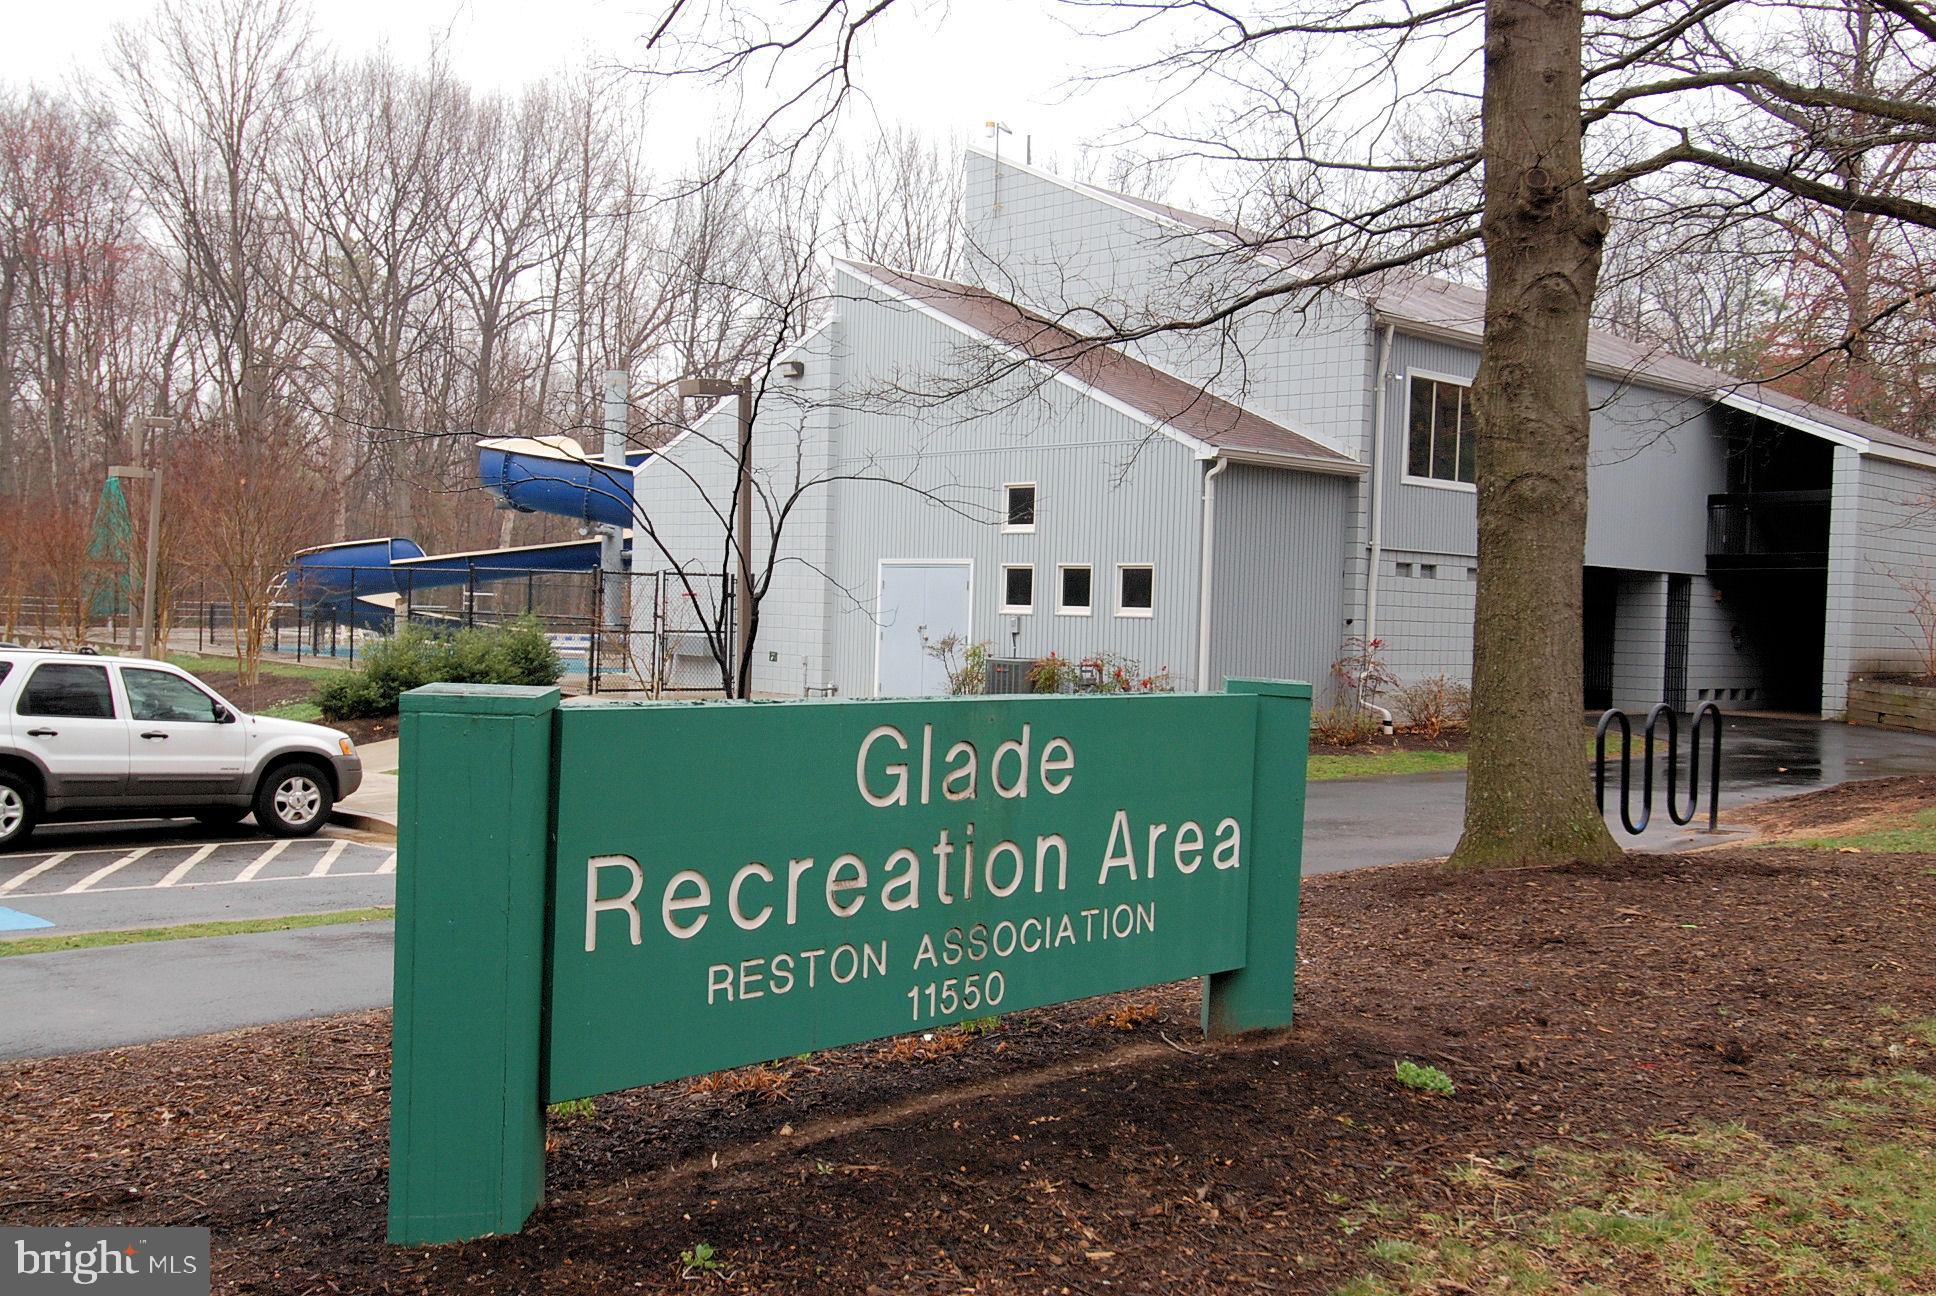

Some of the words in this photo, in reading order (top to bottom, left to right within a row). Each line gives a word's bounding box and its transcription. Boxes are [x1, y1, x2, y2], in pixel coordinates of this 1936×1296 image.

[856, 723, 1075, 808] Glade
[584, 821, 1068, 953] Recreation
[1097, 810, 1241, 885] Area
[707, 939, 888, 1005] RESTON
[912, 901, 1155, 971] ASSOCIATION
[907, 970, 1005, 1021] 11550
